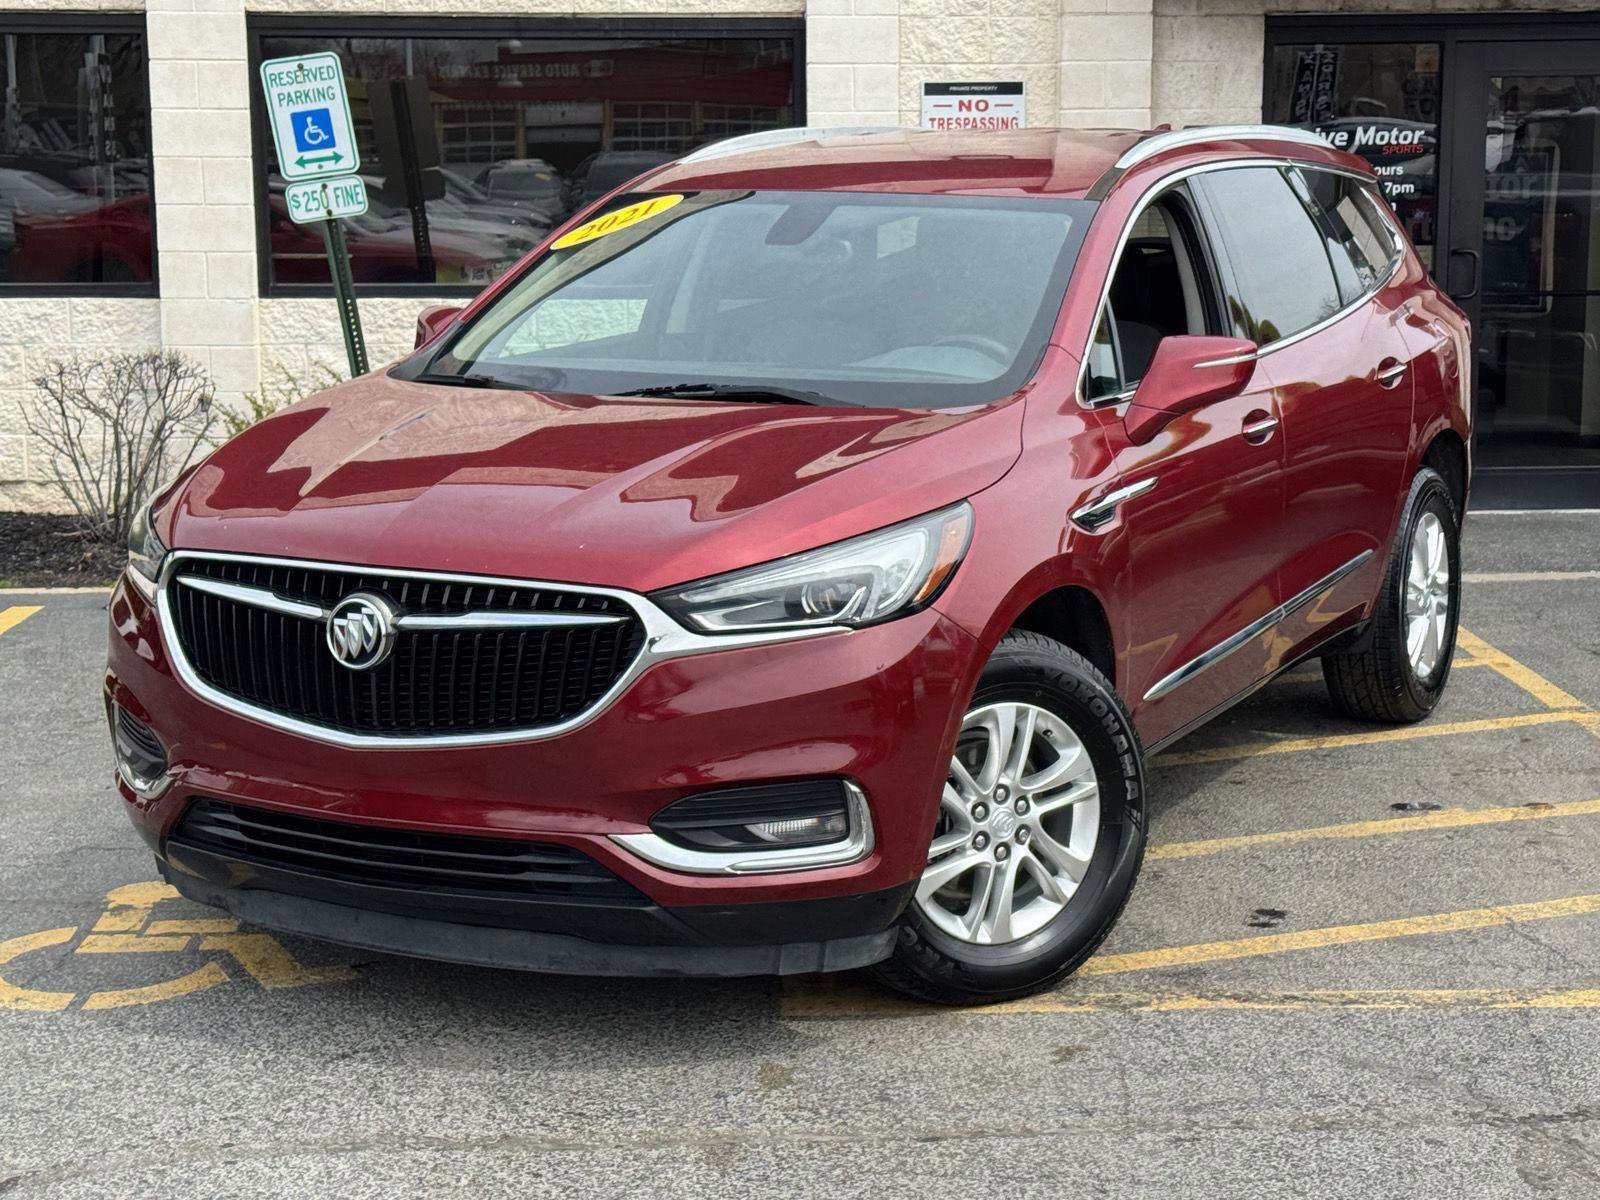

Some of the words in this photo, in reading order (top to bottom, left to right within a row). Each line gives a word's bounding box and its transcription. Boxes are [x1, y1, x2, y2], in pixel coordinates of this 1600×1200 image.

[268, 65, 336, 88] RESERVED
[277, 86, 336, 107] PARKING
[958, 99, 990, 112] NO
[928, 117, 1019, 129] TRESPASSING
[1354, 125, 1425, 146] Motor
[1382, 144, 1424, 155] SPORTS
[1373, 166, 1404, 176] ours
[1384, 182, 1415, 196] 7pm
[291, 188, 330, 212] $250
[333, 184, 364, 208] FINE
[575, 201, 658, 241] 2021
